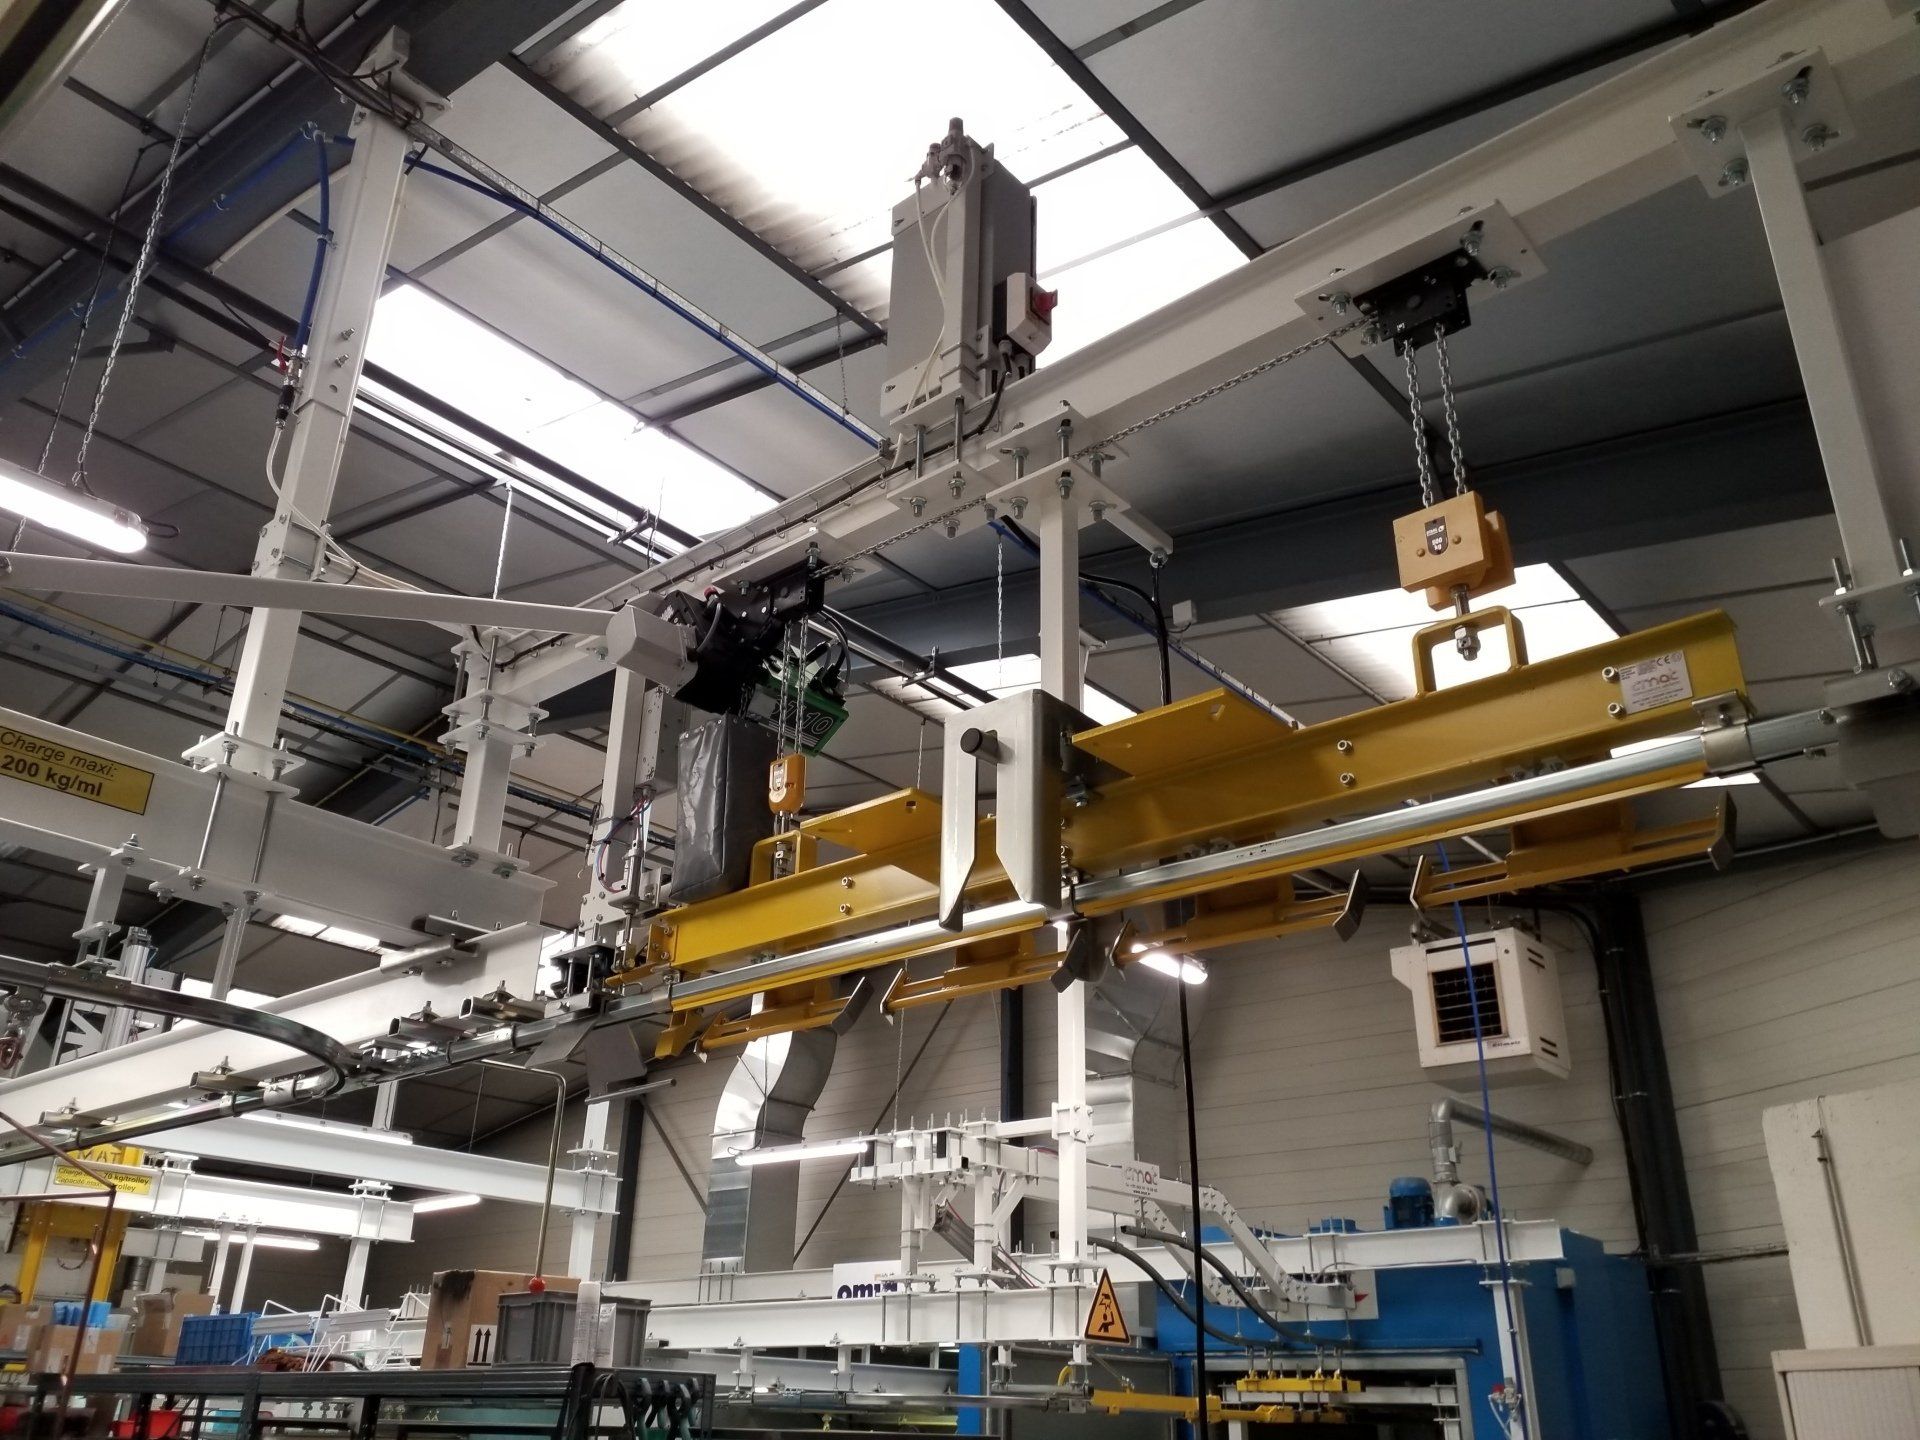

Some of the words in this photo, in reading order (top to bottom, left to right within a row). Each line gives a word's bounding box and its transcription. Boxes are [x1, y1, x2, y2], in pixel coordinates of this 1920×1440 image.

[0, 731, 66, 762] Charge
[69, 756, 118, 778] maxi:
[0, 754, 40, 777] 200
[45, 767, 103, 791] kg/ml
